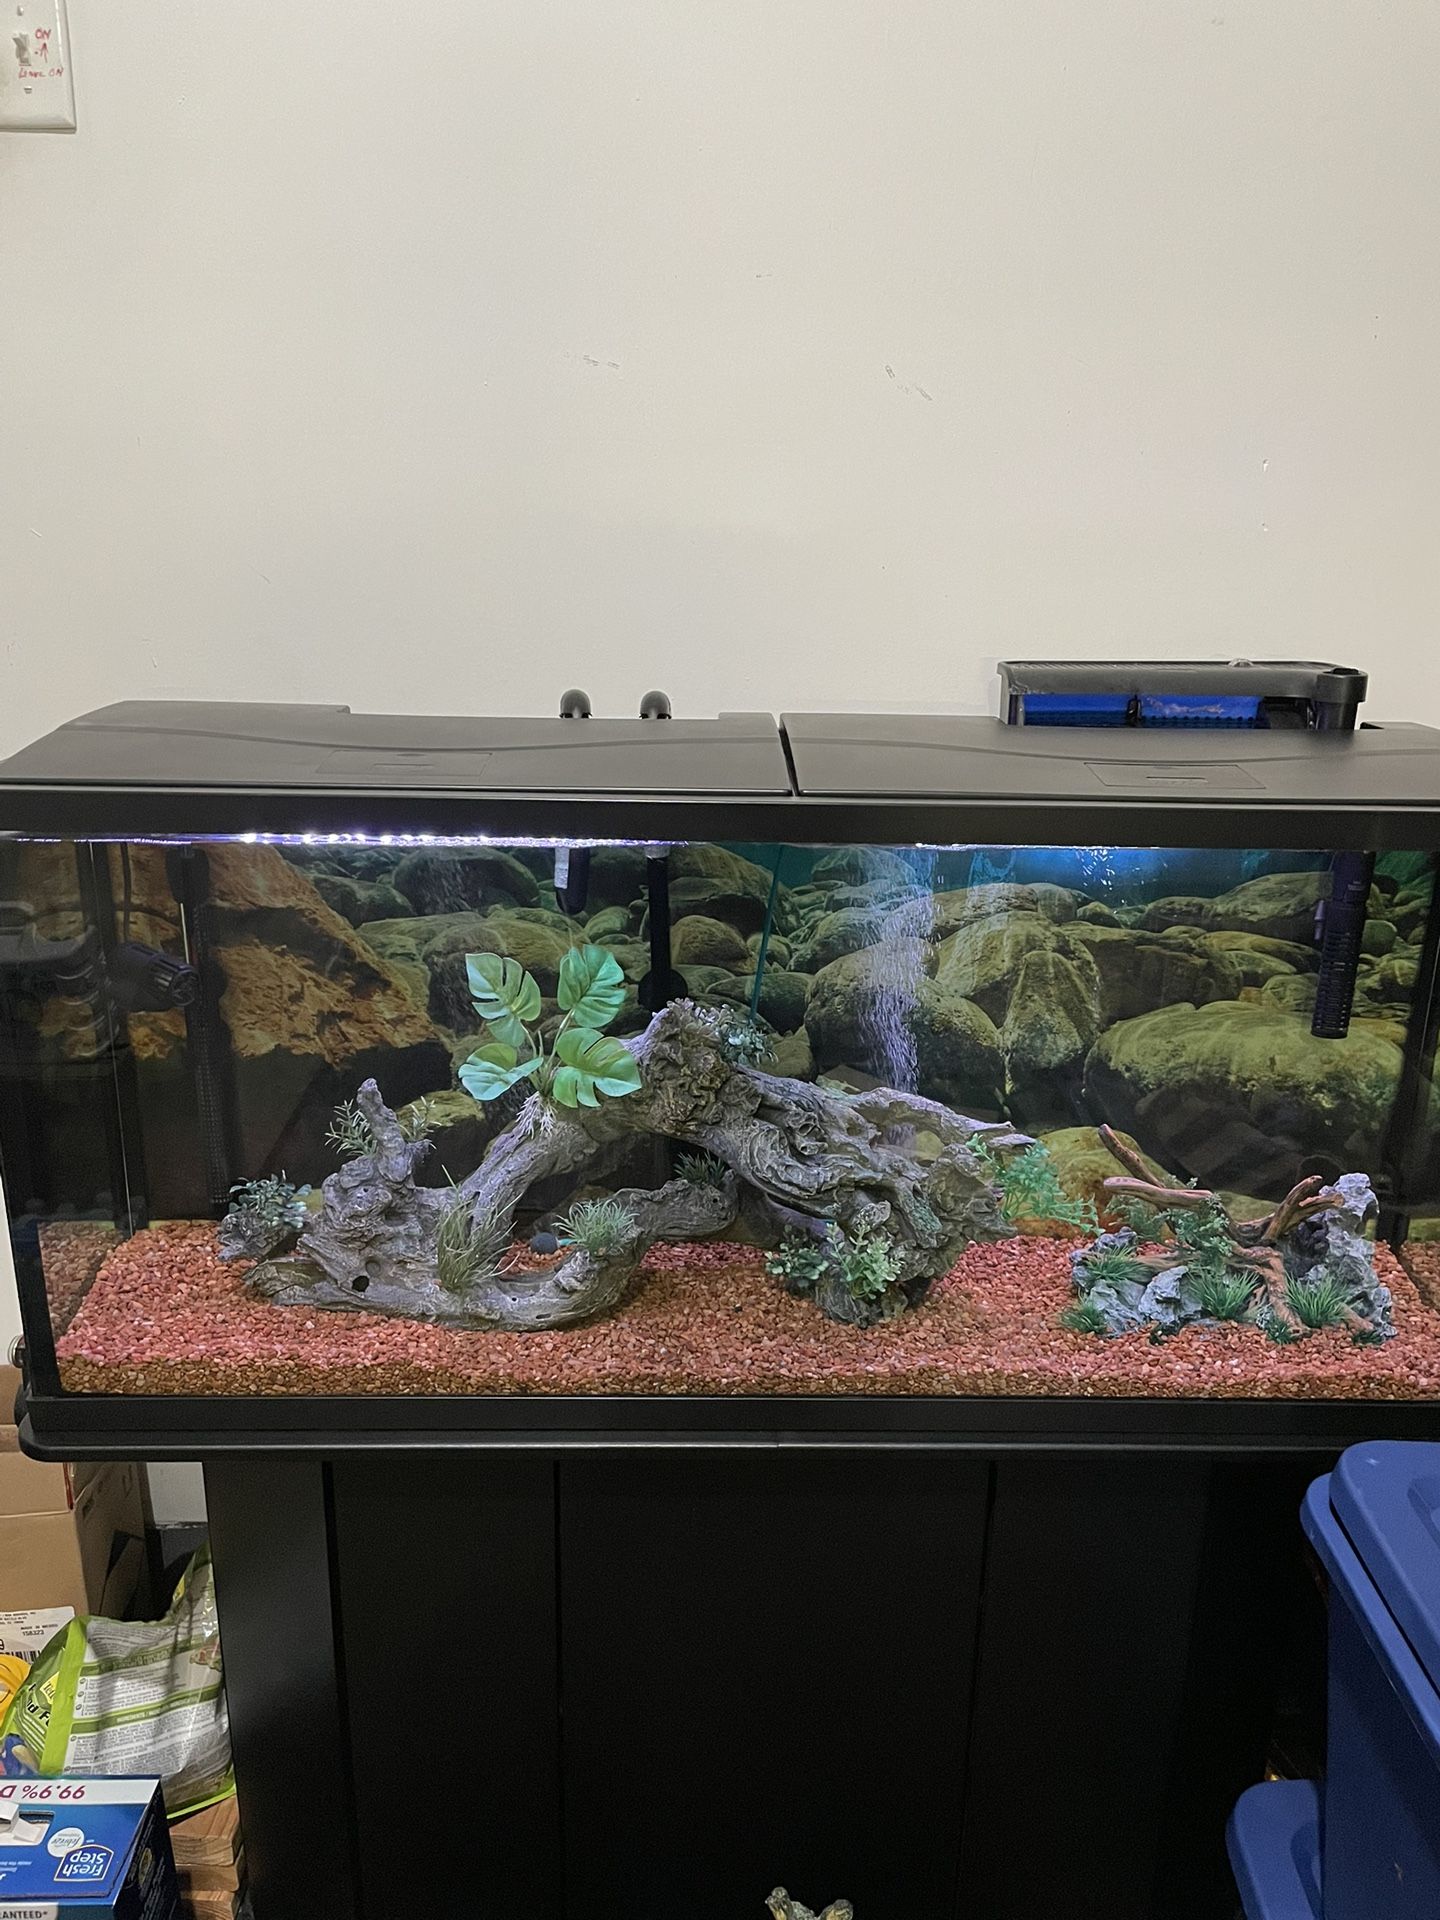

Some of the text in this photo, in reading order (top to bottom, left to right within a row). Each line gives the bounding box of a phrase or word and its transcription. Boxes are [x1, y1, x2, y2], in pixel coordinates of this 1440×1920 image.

[35, 28, 52, 40] ON
[21, 1784, 86, 1800] 99.9%
[69, 1850, 107, 1865] Step
[62, 1863, 105, 1877] Fresh
